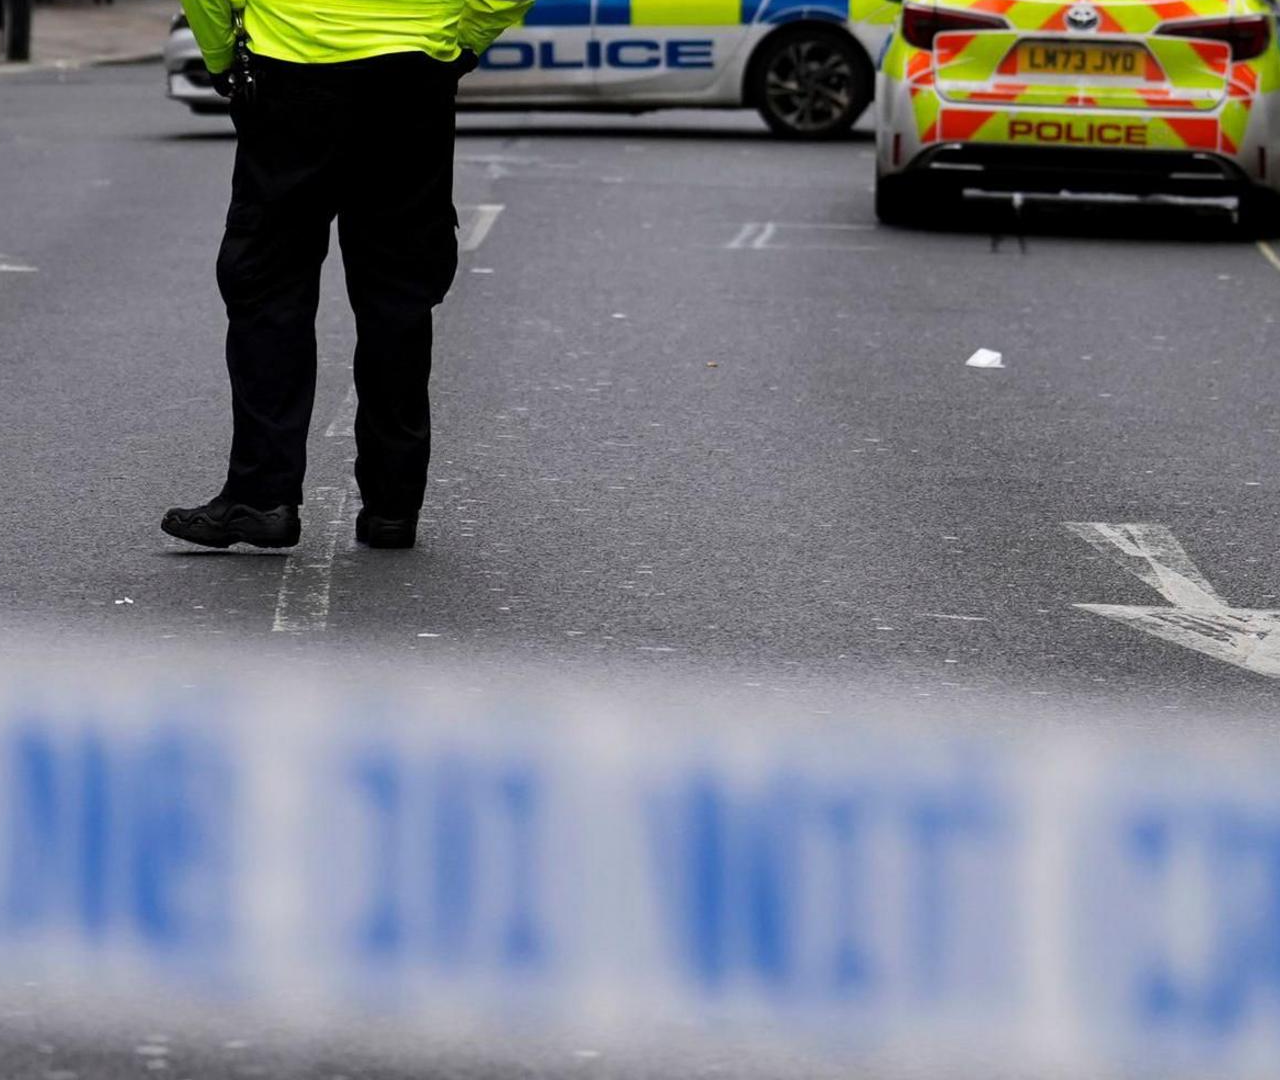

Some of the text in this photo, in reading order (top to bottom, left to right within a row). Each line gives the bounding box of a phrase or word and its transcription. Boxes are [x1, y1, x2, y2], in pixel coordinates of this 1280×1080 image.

[477, 39, 715, 70] OLICE
[1029, 48, 1086, 70] LM73
[1008, 120, 1148, 146] POLICE
